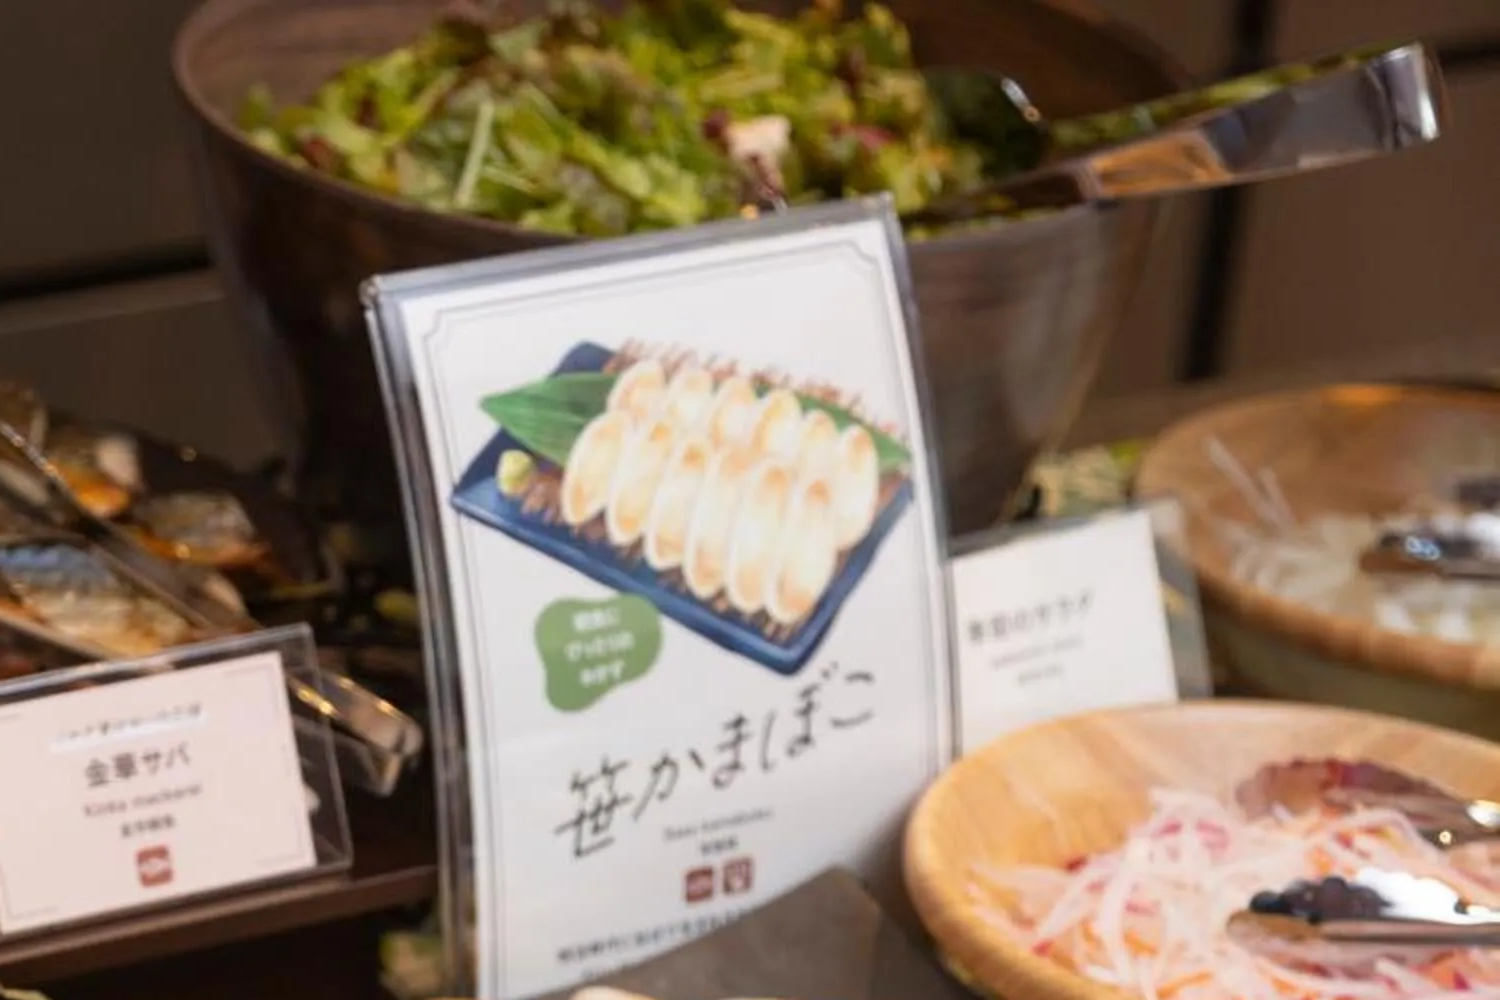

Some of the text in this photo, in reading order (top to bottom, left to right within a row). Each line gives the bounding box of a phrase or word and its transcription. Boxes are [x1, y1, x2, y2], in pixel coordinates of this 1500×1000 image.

[554, 661, 874, 858] 笹かまぼこ
